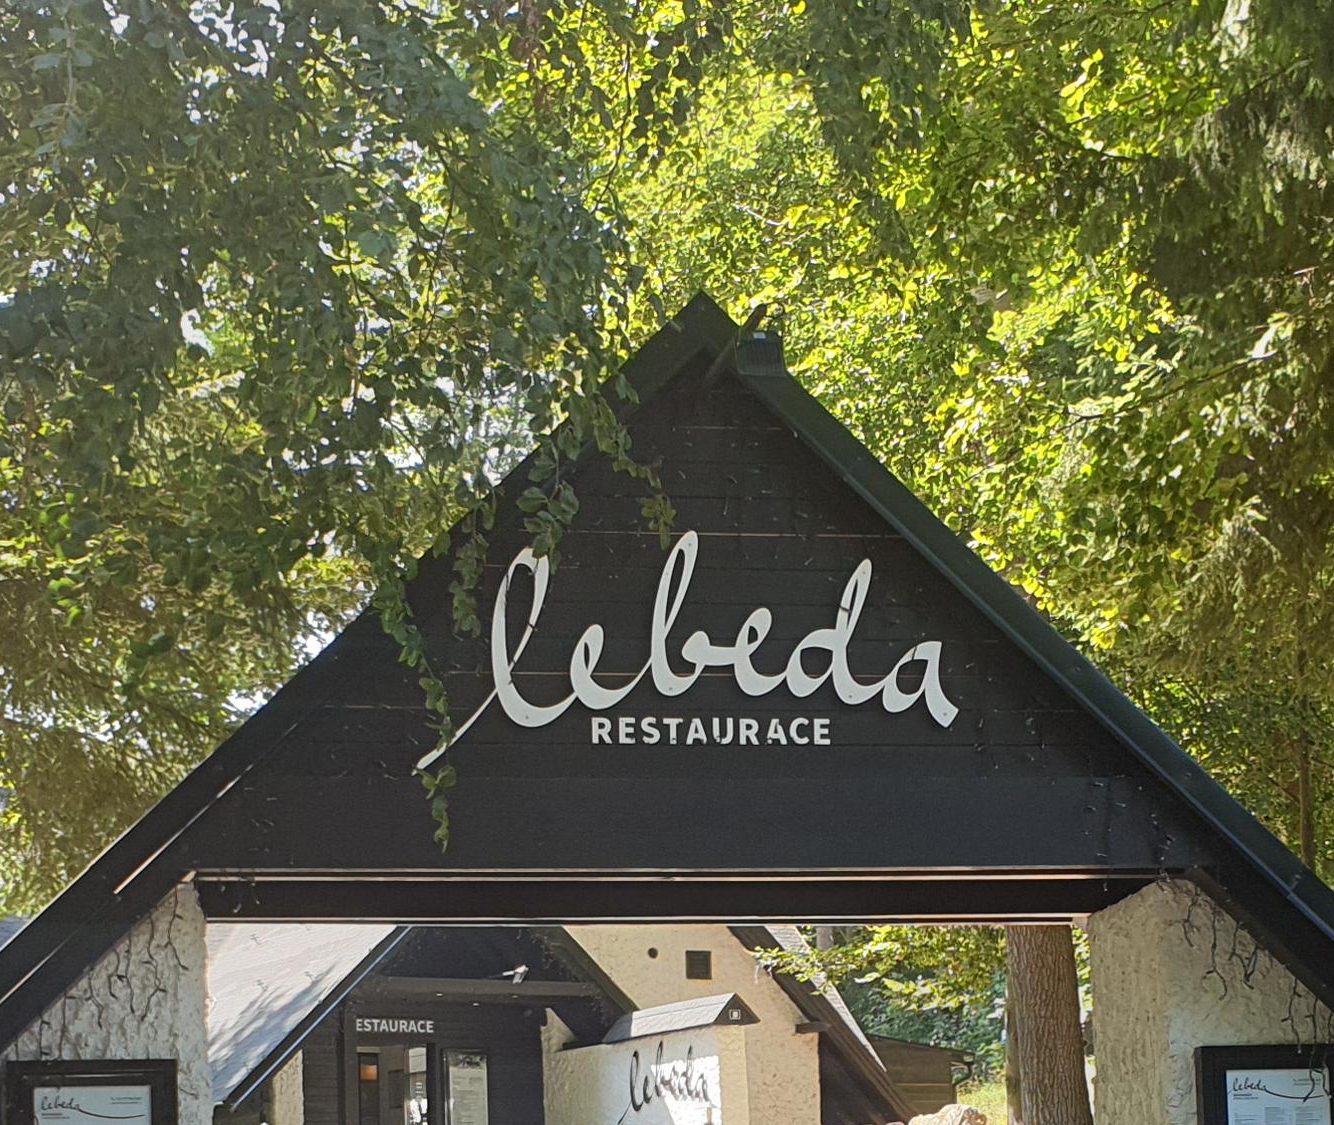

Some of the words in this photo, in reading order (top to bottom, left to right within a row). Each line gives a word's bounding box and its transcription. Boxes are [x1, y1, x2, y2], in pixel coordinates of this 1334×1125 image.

[413, 529, 960, 774] lebeda
[590, 716, 833, 747] RESTAURACE
[355, 1018, 435, 1033] ESTAURACE
